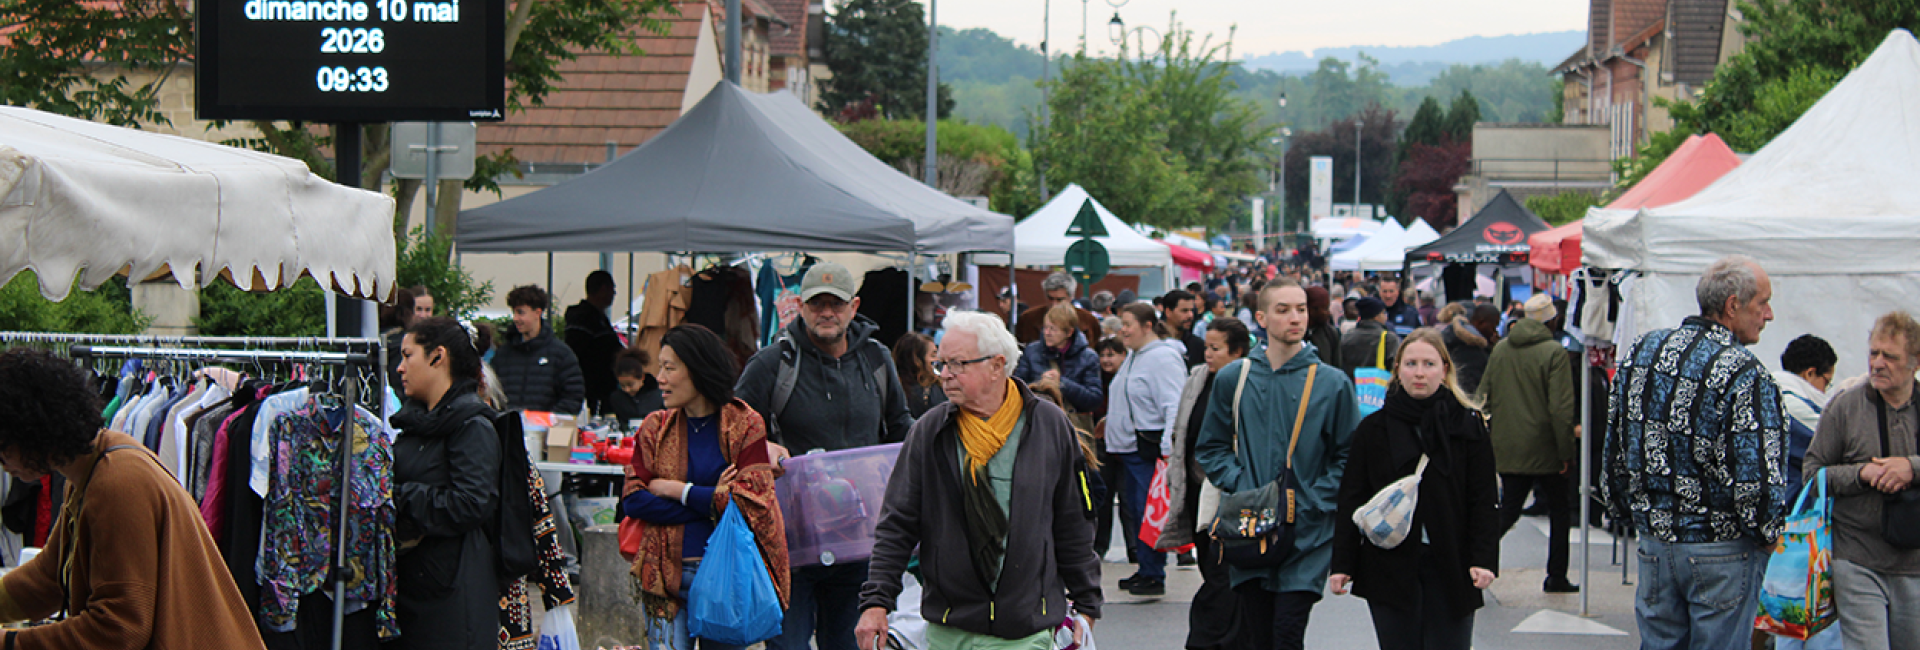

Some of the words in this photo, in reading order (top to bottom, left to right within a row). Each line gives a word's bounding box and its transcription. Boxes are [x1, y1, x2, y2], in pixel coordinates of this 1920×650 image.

[244, 0, 369, 21] dimanche
[375, 0, 408, 22] 10
[413, 0, 460, 22] mai
[320, 28, 385, 53] 2026
[317, 67, 389, 92] 09:33
